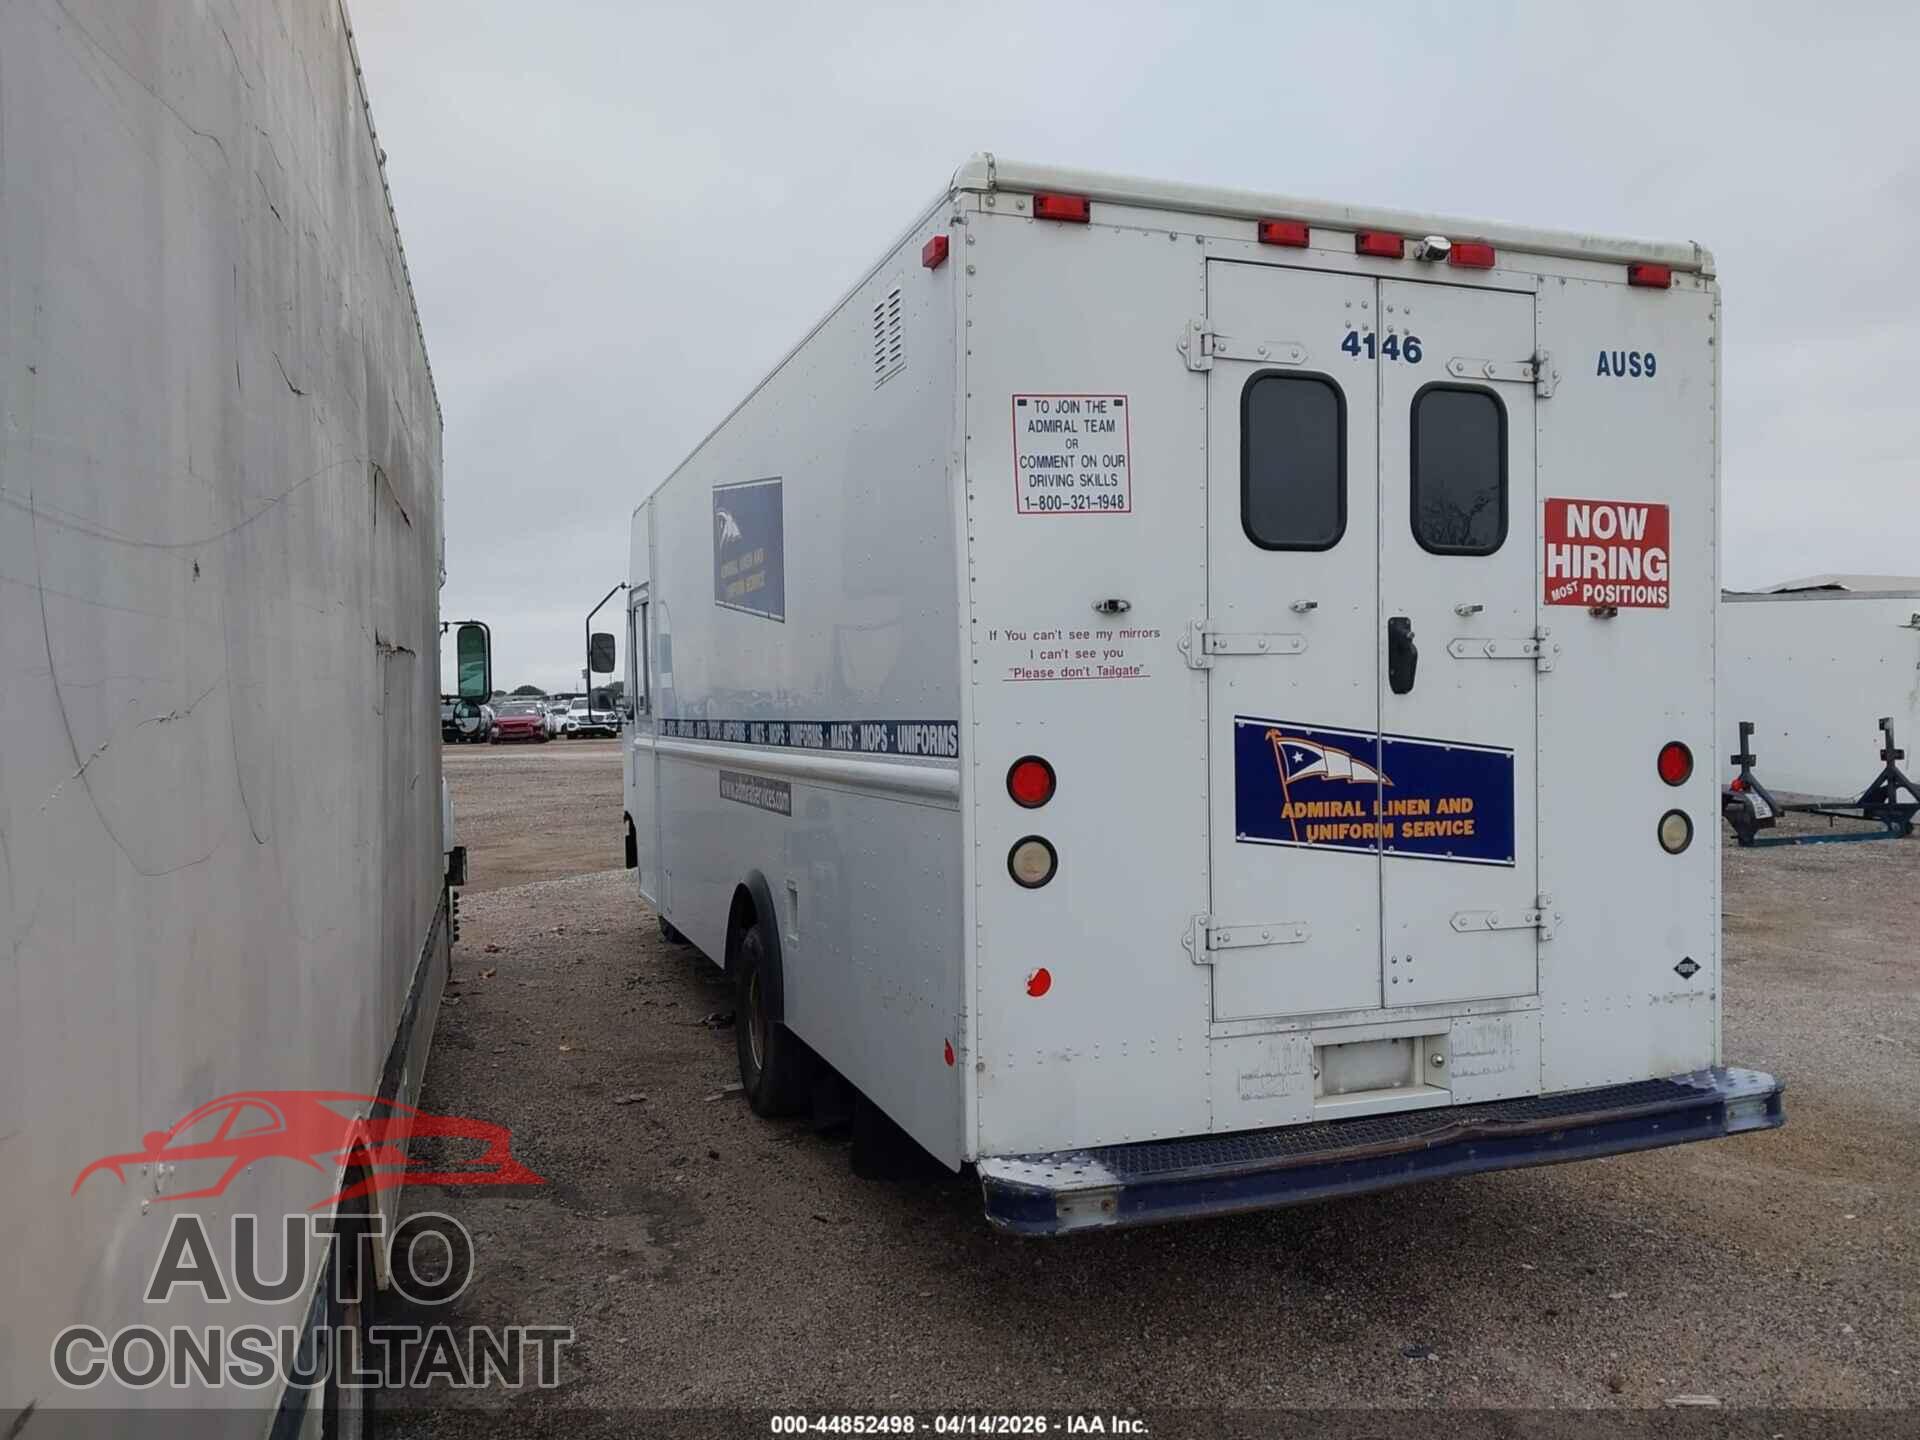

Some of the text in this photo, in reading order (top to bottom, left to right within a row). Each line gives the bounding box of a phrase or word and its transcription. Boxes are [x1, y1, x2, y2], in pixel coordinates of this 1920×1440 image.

[1341, 331, 1423, 364] 4146
[1597, 351, 1657, 378] AUS9
[1034, 400, 1107, 414] TO JOIN THE
[1028, 419, 1115, 433] ADMIRAL TEAM
[1065, 438, 1079, 449] OR
[1019, 455, 1125, 468] COMMENT ON OUR
[1029, 474, 1118, 488] DRIVING SKILLS
[1024, 495, 1124, 510] 1-800-321-1948
[1567, 504, 1648, 541] NOW
[1547, 543, 1668, 581] HIRING
[1551, 581, 1668, 604] MOST POSITIONS
[989, 628, 1161, 641] If You can't see my mirrors
[1030, 649, 1124, 660] I can't see you
[1060, 667, 1090, 677] don't
[790, 724, 823, 747] UNIFORMS
[830, 724, 853, 749] MATS
[860, 724, 887, 751] MOPS
[897, 725, 957, 756] UNIFORMS
[1281, 797, 1473, 819] ADMIRAL LINEN AND
[1306, 819, 1474, 840] UNIFORM SERVICE
